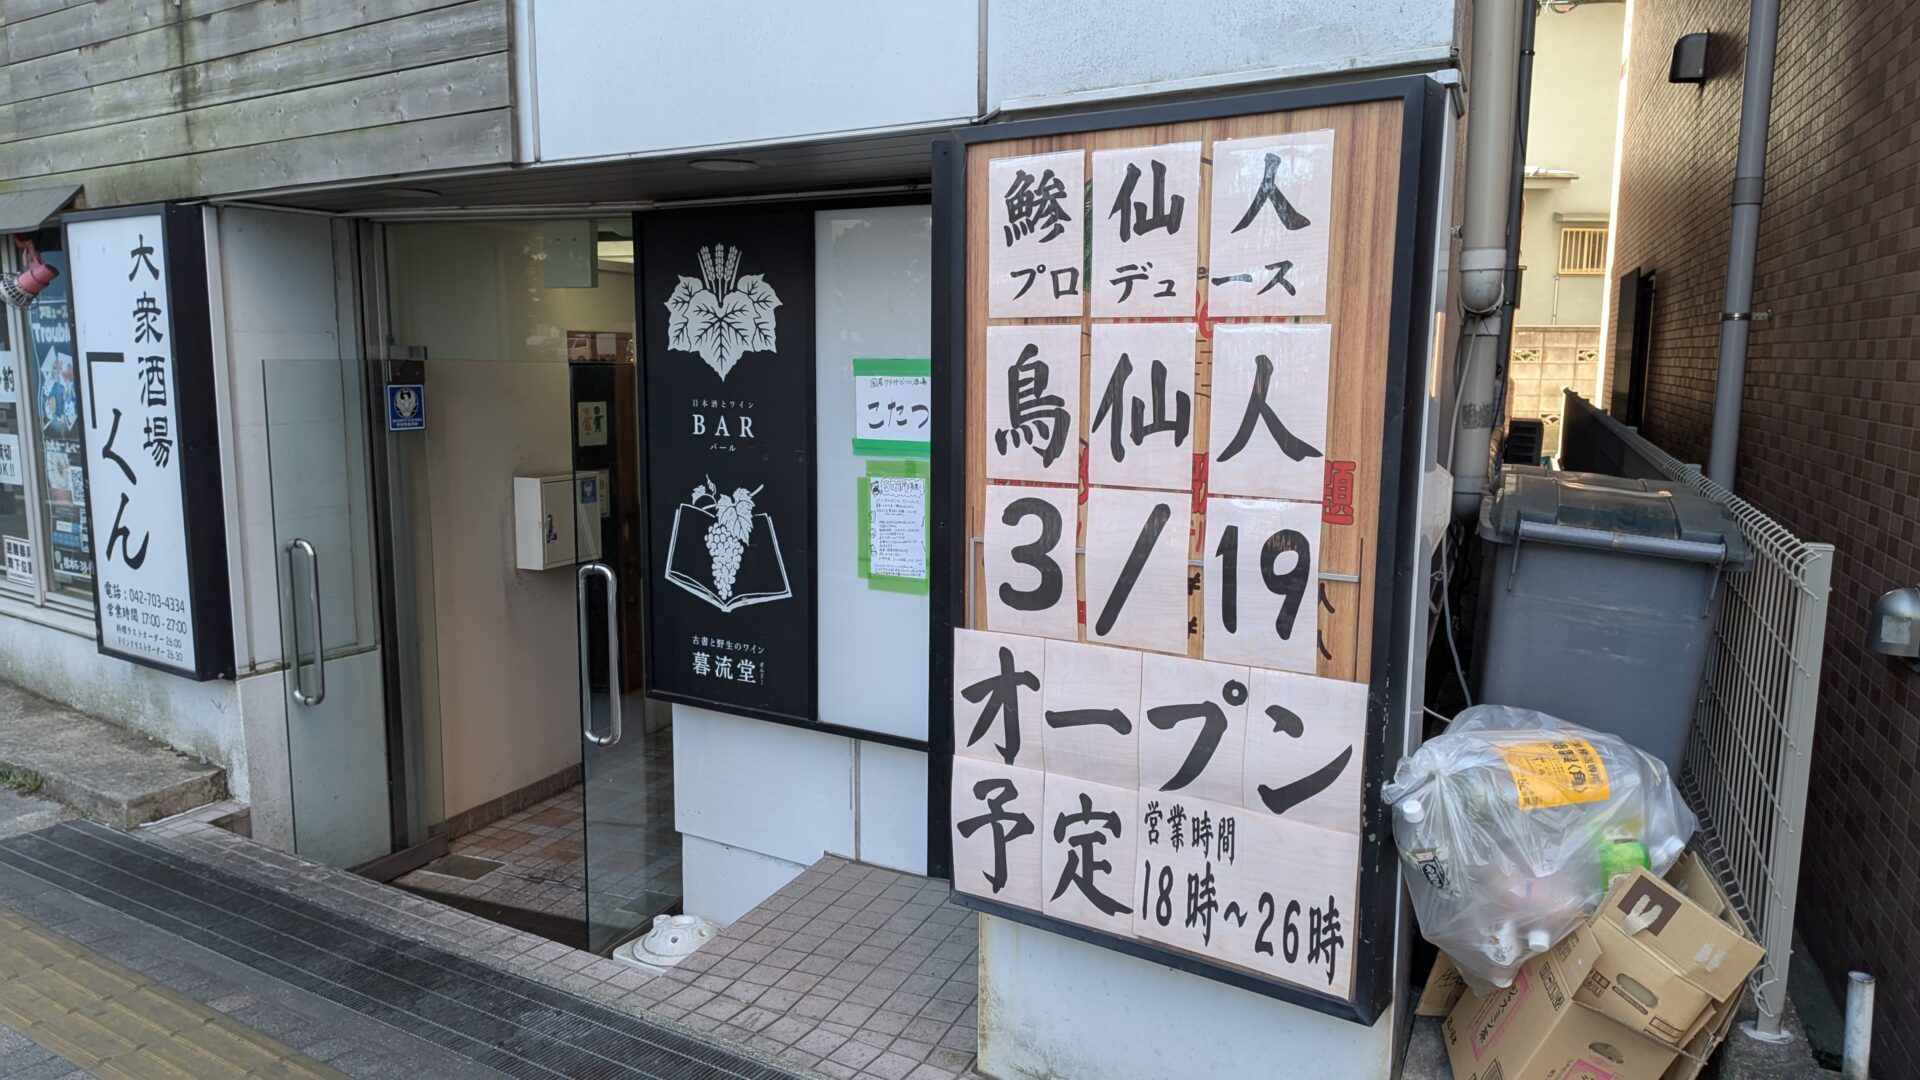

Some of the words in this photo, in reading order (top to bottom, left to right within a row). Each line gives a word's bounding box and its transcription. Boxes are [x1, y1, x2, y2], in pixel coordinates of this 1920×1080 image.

[128, 234, 174, 468] 大衆酒場
[692, 399, 754, 409] 日本酒とワイン
[867, 400, 929, 430] こたつ
[994, 343, 1324, 469] 鳥仙人
[692, 414, 755, 438] BAR
[107, 603, 139, 623] 営業時間
[692, 635, 765, 654] 古書と野生のワイン
[692, 651, 757, 684] 暮流堂
[961, 646, 1353, 815] オープン
[957, 778, 1134, 917] 予定
[1143, 800, 1236, 866] 営業時間
